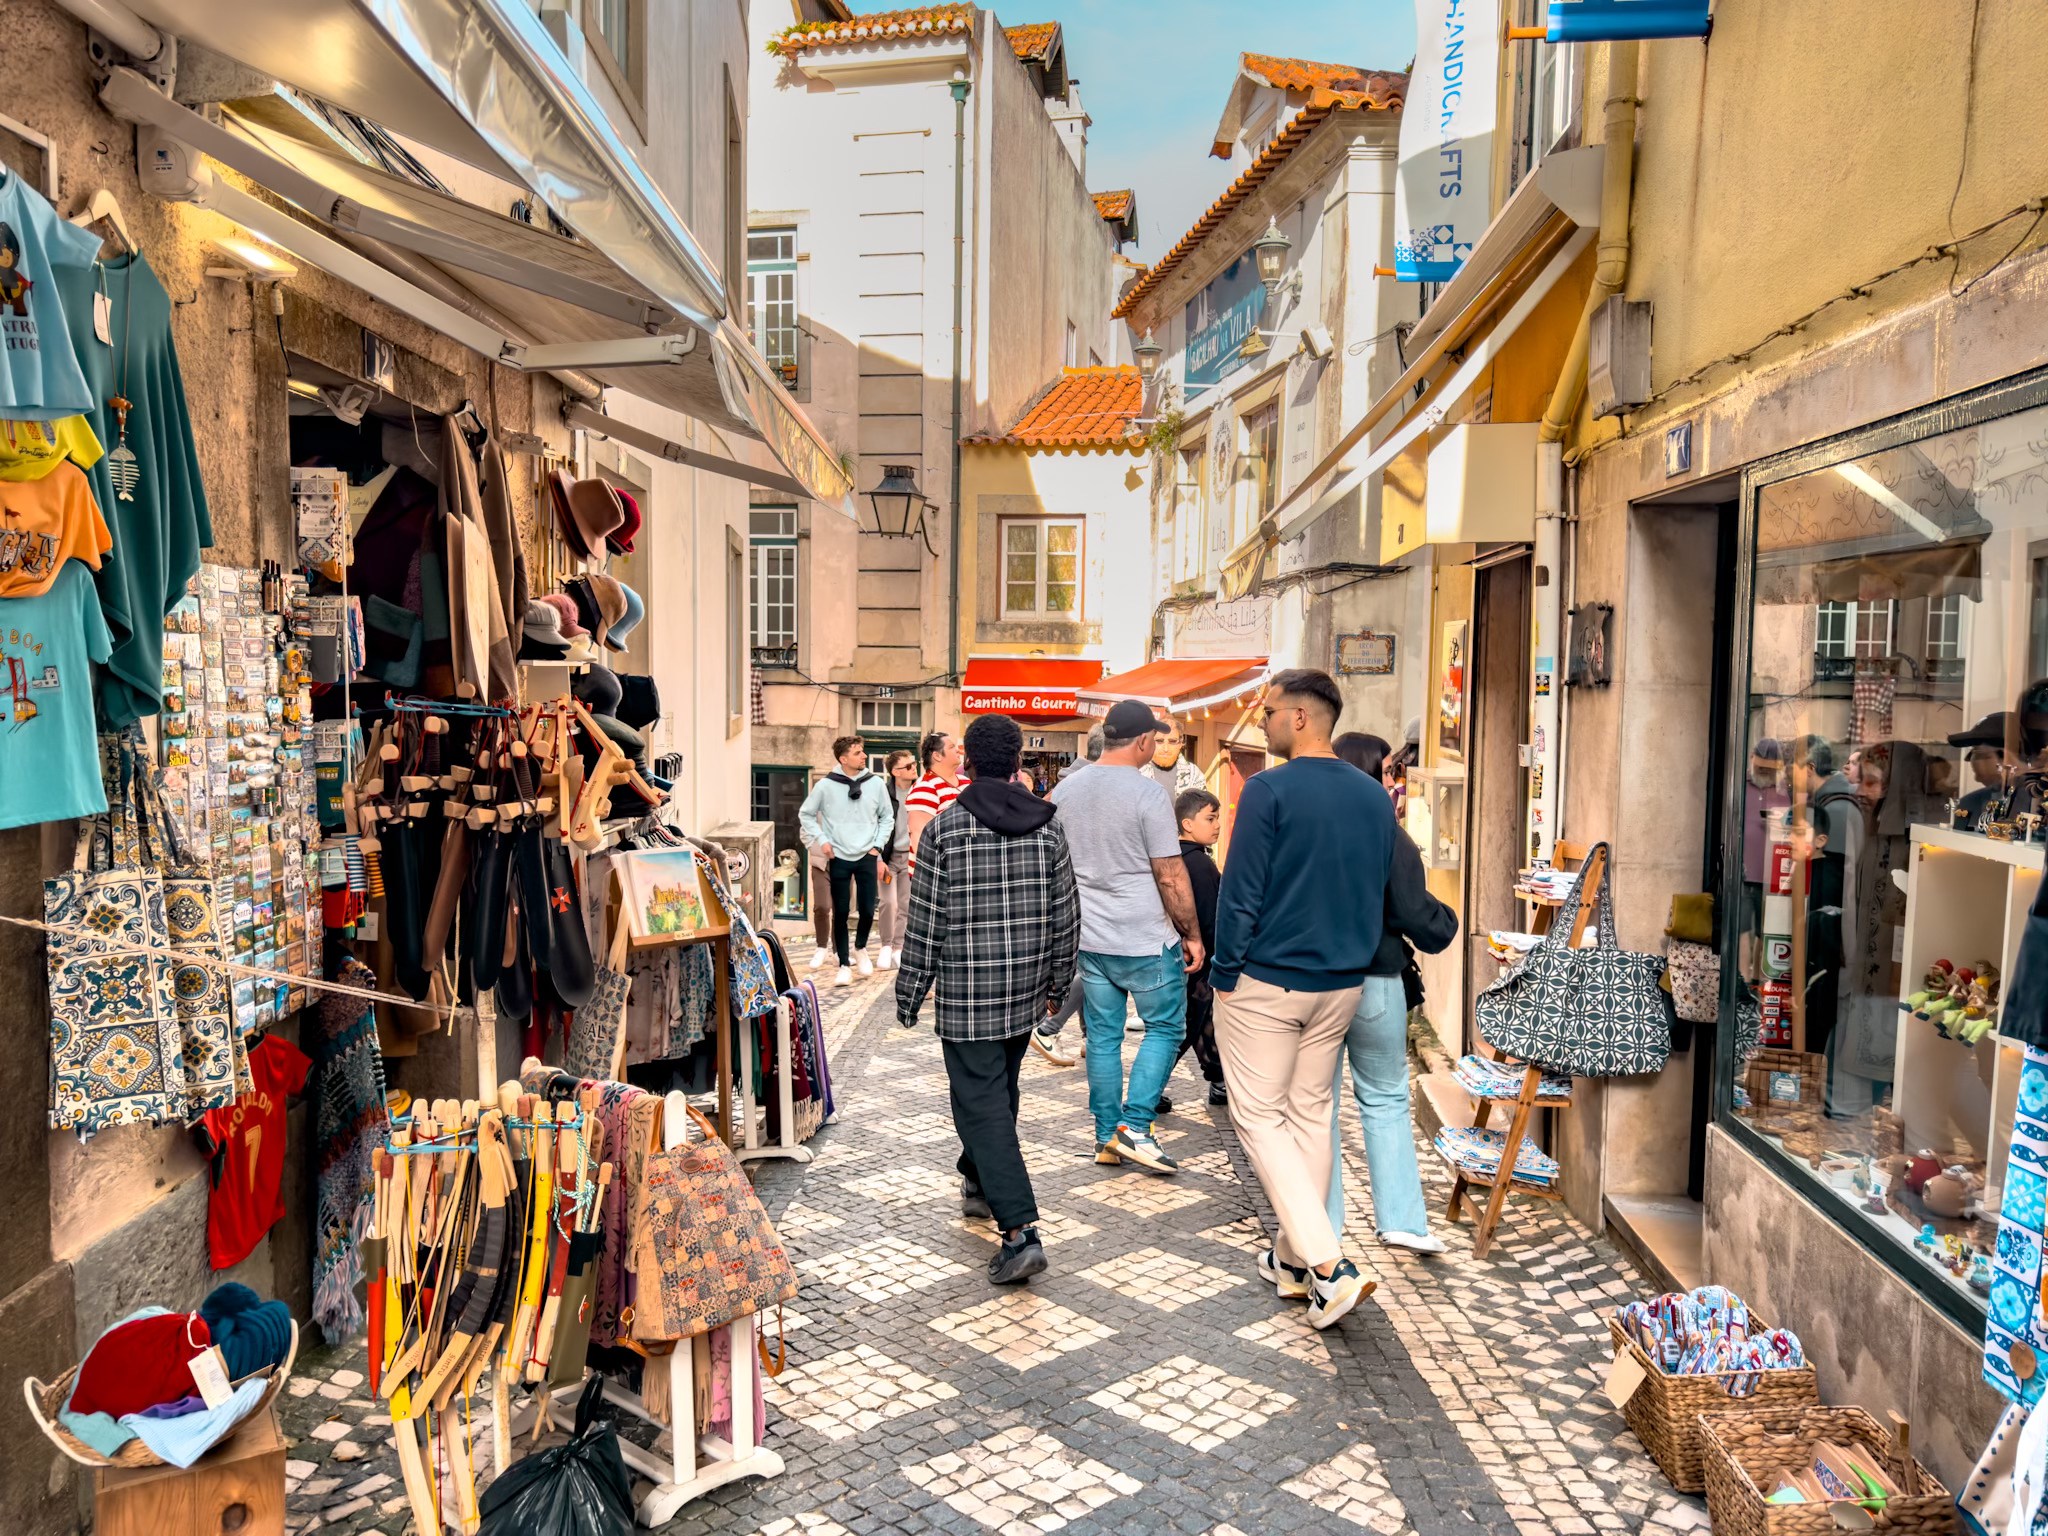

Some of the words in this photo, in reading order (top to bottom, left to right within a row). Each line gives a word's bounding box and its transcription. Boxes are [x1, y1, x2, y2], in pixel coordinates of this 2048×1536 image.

[1230, 305, 1251, 345] VILA
[19, 445, 52, 458] Portugal
[964, 695, 1027, 709] Cantinho
[1032, 737, 1043, 748] 17
[245, 1124, 261, 1194] 7
